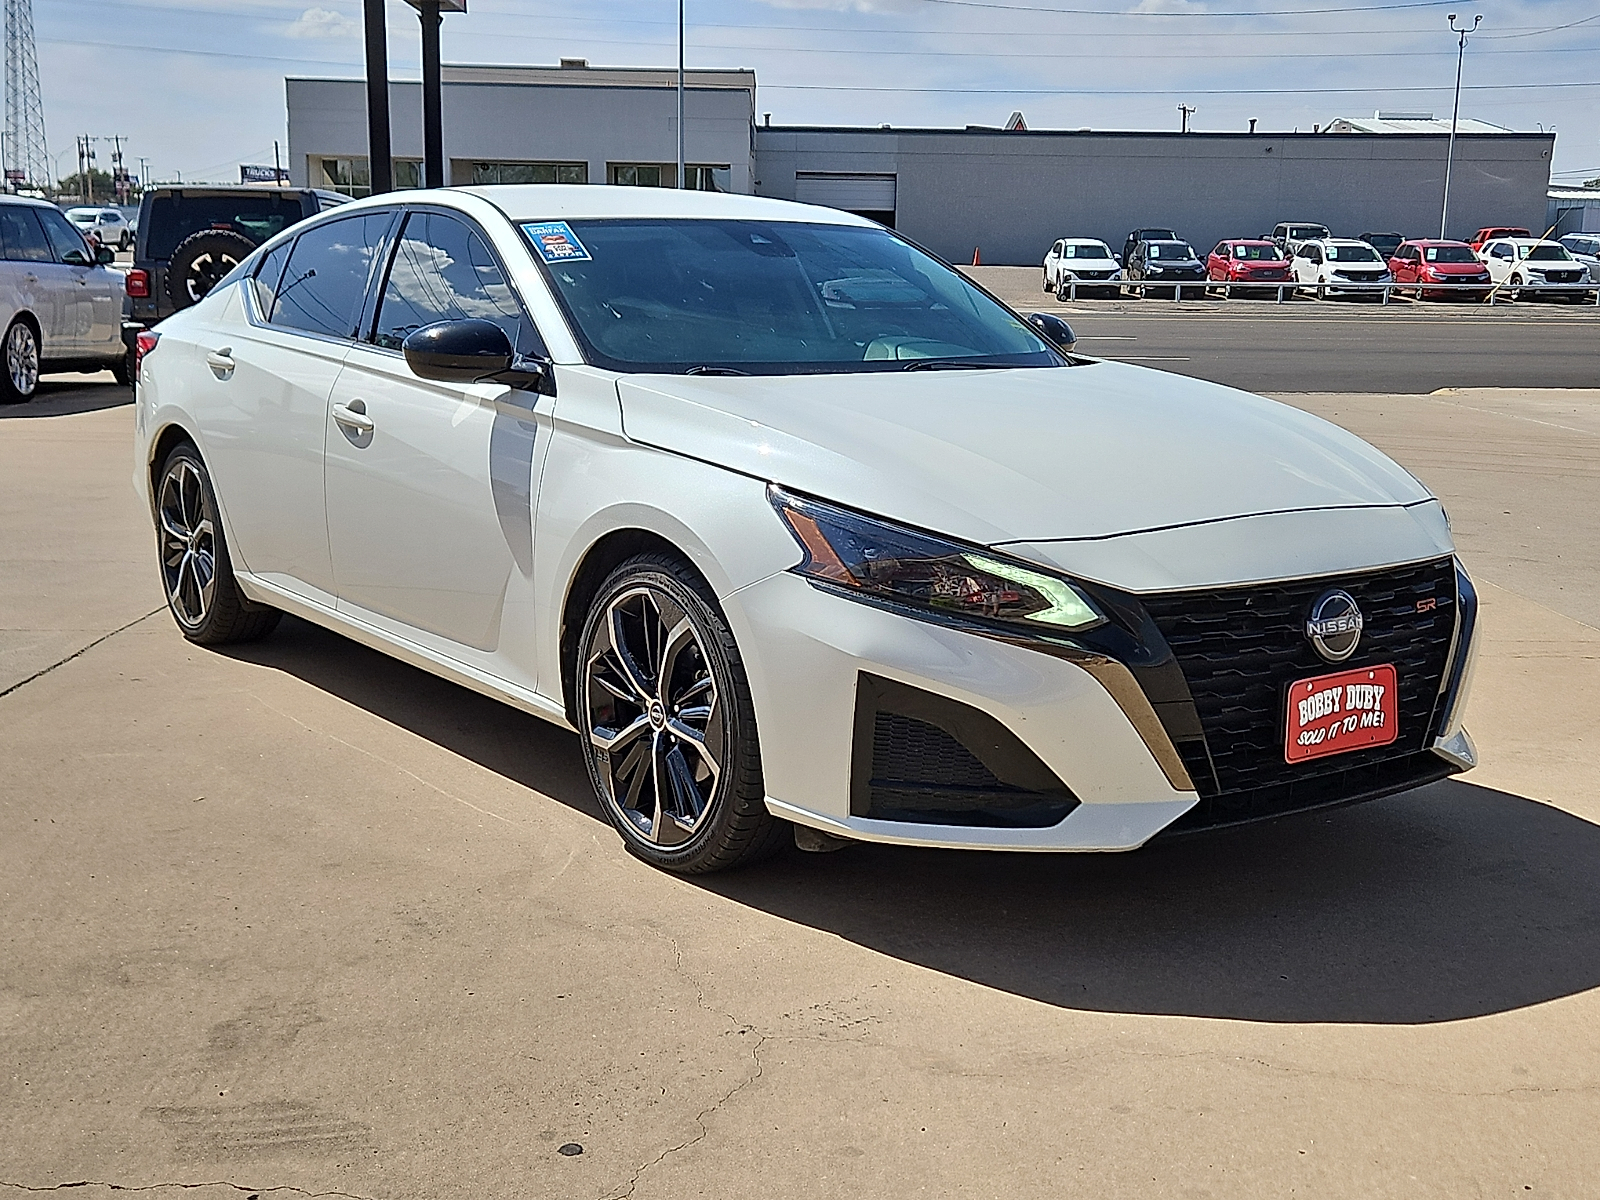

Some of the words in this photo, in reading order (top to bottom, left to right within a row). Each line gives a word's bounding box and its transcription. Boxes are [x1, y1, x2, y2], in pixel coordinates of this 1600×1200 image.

[246, 168, 275, 177] TRUCKS
[1416, 598, 1436, 613] SR
[1309, 617, 1362, 634] NISSAN
[1298, 686, 1342, 727] BOBBY
[1345, 685, 1385, 711] DUBY
[1297, 728, 1326, 745] SOLD
[1327, 721, 1342, 740] IT
[1342, 715, 1358, 735] TO
[1360, 711, 1385, 728] ME!
